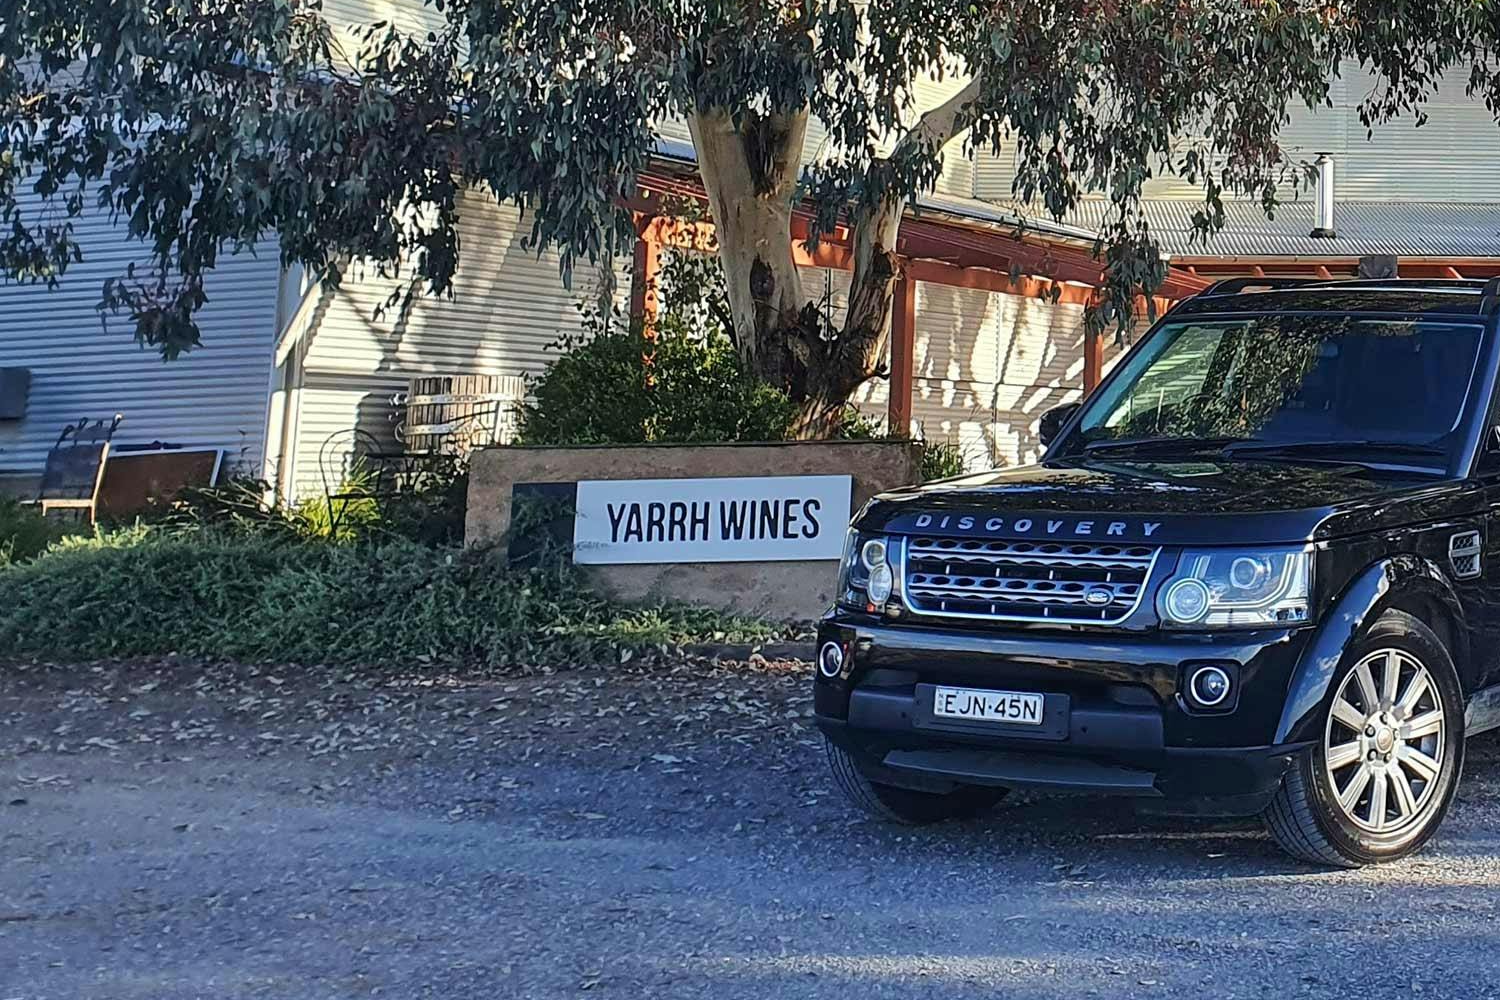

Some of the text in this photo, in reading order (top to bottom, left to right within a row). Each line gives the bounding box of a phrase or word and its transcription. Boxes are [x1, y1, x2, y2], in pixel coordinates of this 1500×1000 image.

[607, 499, 821, 543] YARRH WINES
[915, 514, 1161, 536] DISCOVERY
